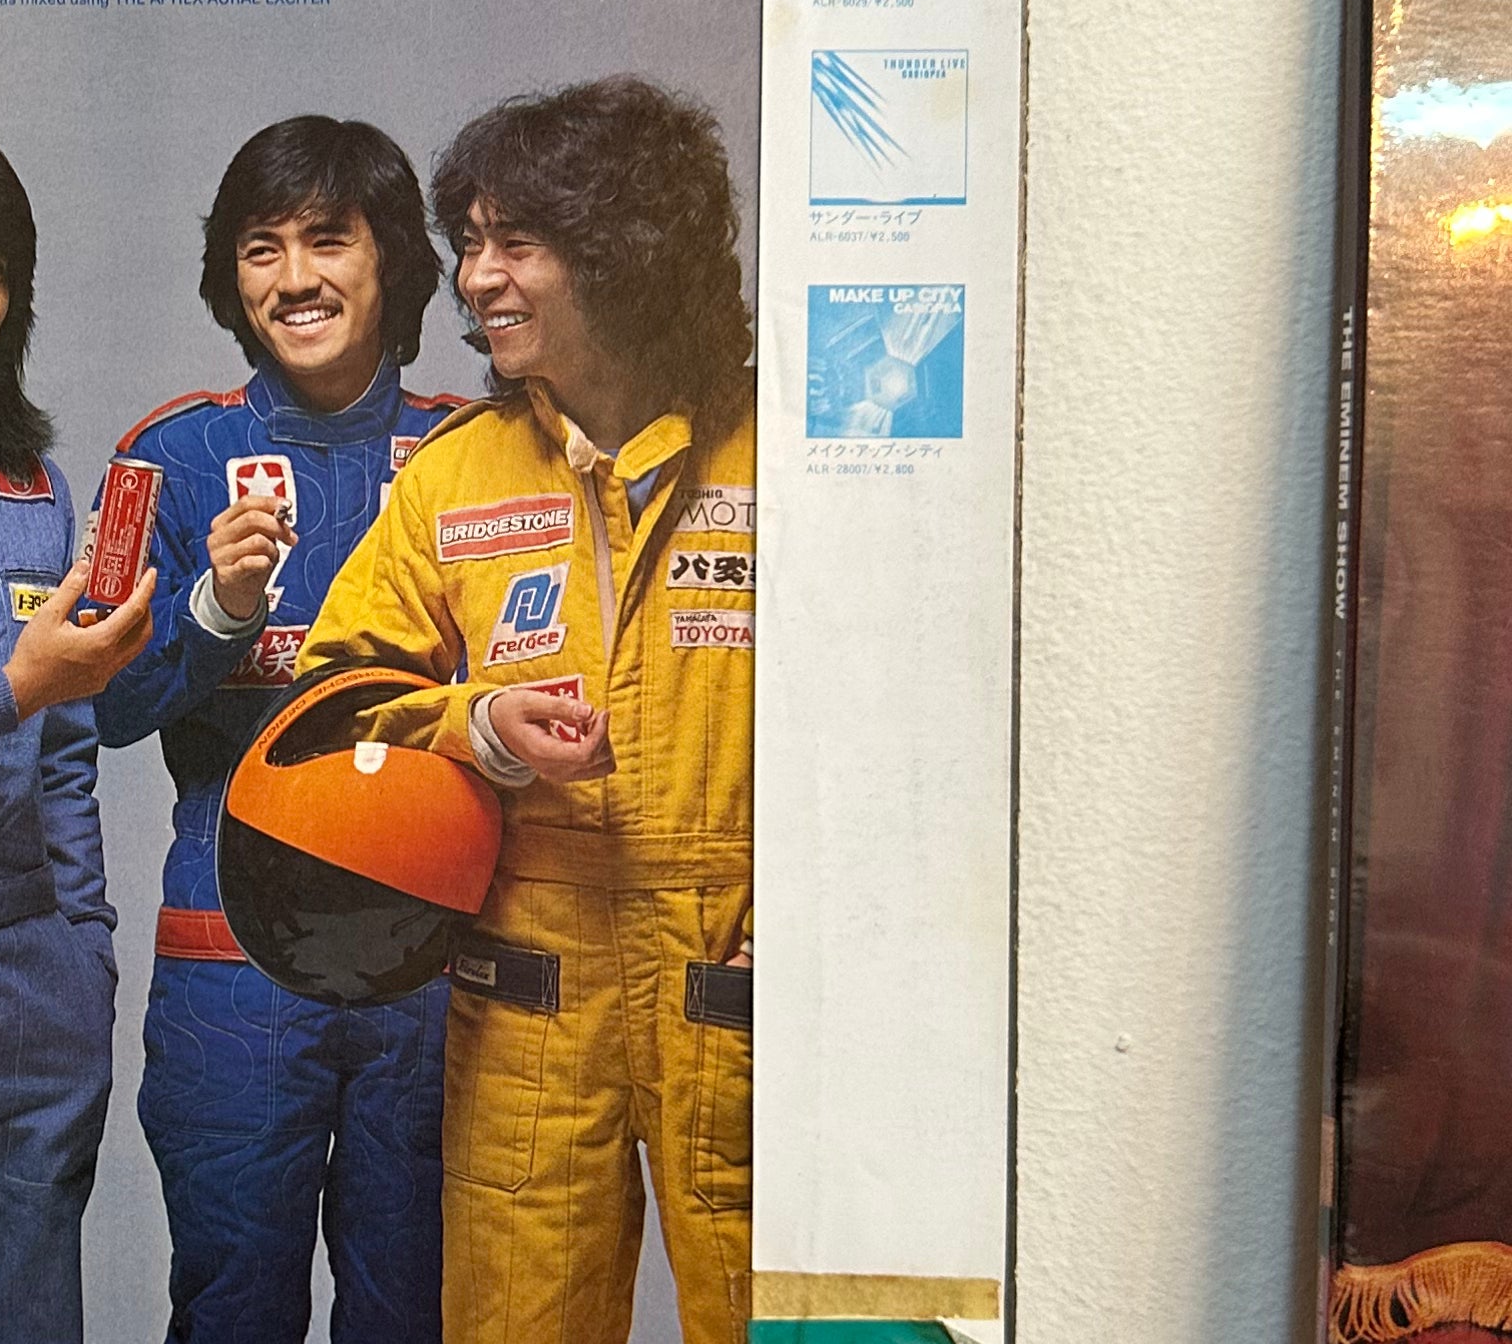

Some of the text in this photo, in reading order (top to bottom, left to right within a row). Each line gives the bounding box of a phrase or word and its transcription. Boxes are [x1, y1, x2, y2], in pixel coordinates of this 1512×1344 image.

[809, 210, 922, 225] サンダー・ライブ
[829, 287, 962, 303] MAKE UP CITY
[807, 442, 943, 458] メイク・アップ・シティ
[1334, 305, 1354, 618] THE EMINEM SHOW
[441, 509, 570, 544] BRIDGESTONE
[675, 625, 752, 642] TOYOTA
